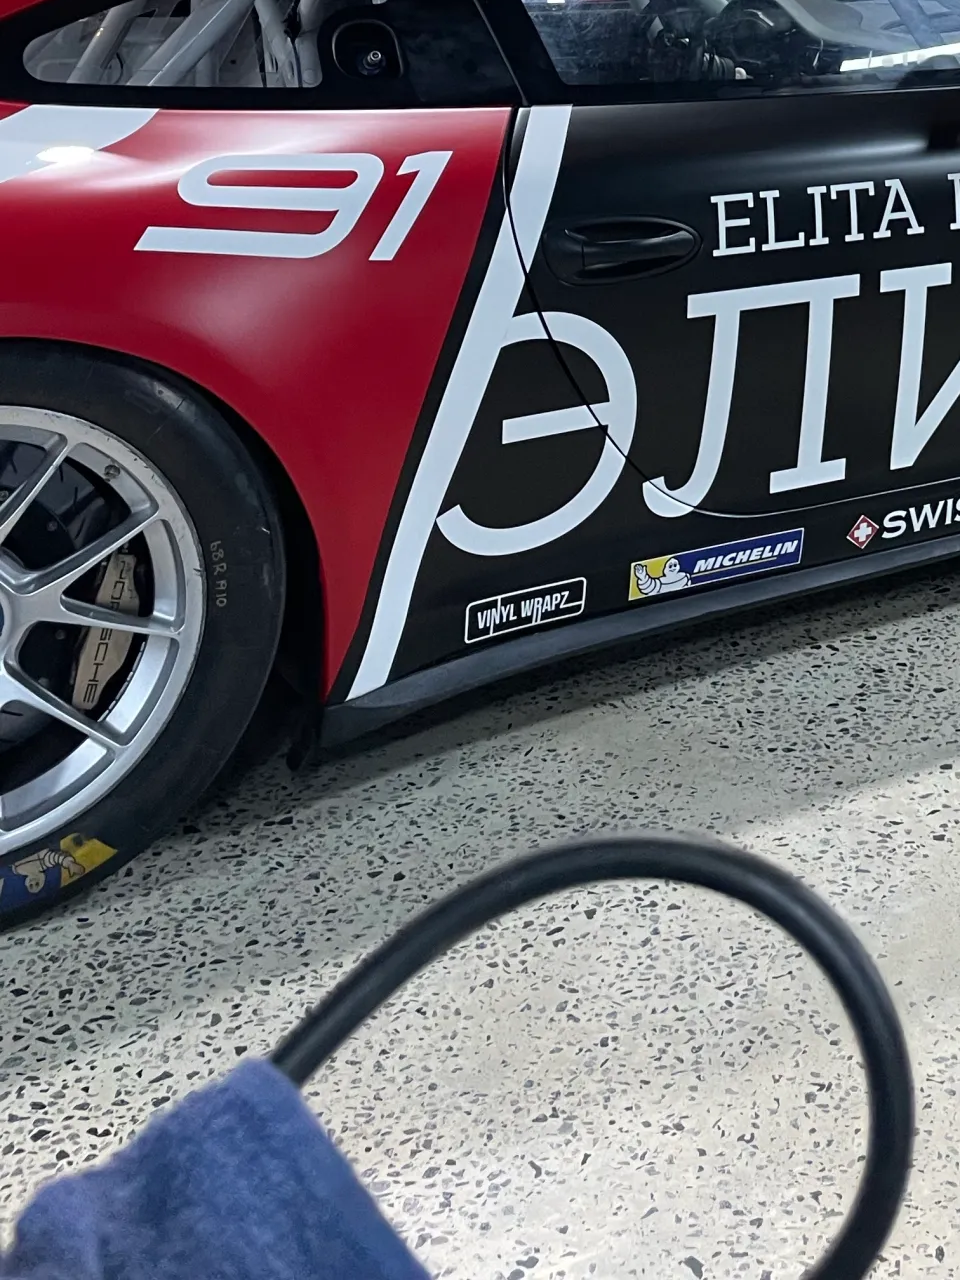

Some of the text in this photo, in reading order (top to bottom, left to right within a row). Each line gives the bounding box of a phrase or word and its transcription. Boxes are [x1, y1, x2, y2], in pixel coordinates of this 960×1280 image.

[133, 150, 453, 261] 91
[710, 178, 924, 258] ELITA
[693, 539, 799, 574] MICHELIN
[477, 591, 572, 632] VINYL WRAPZ
